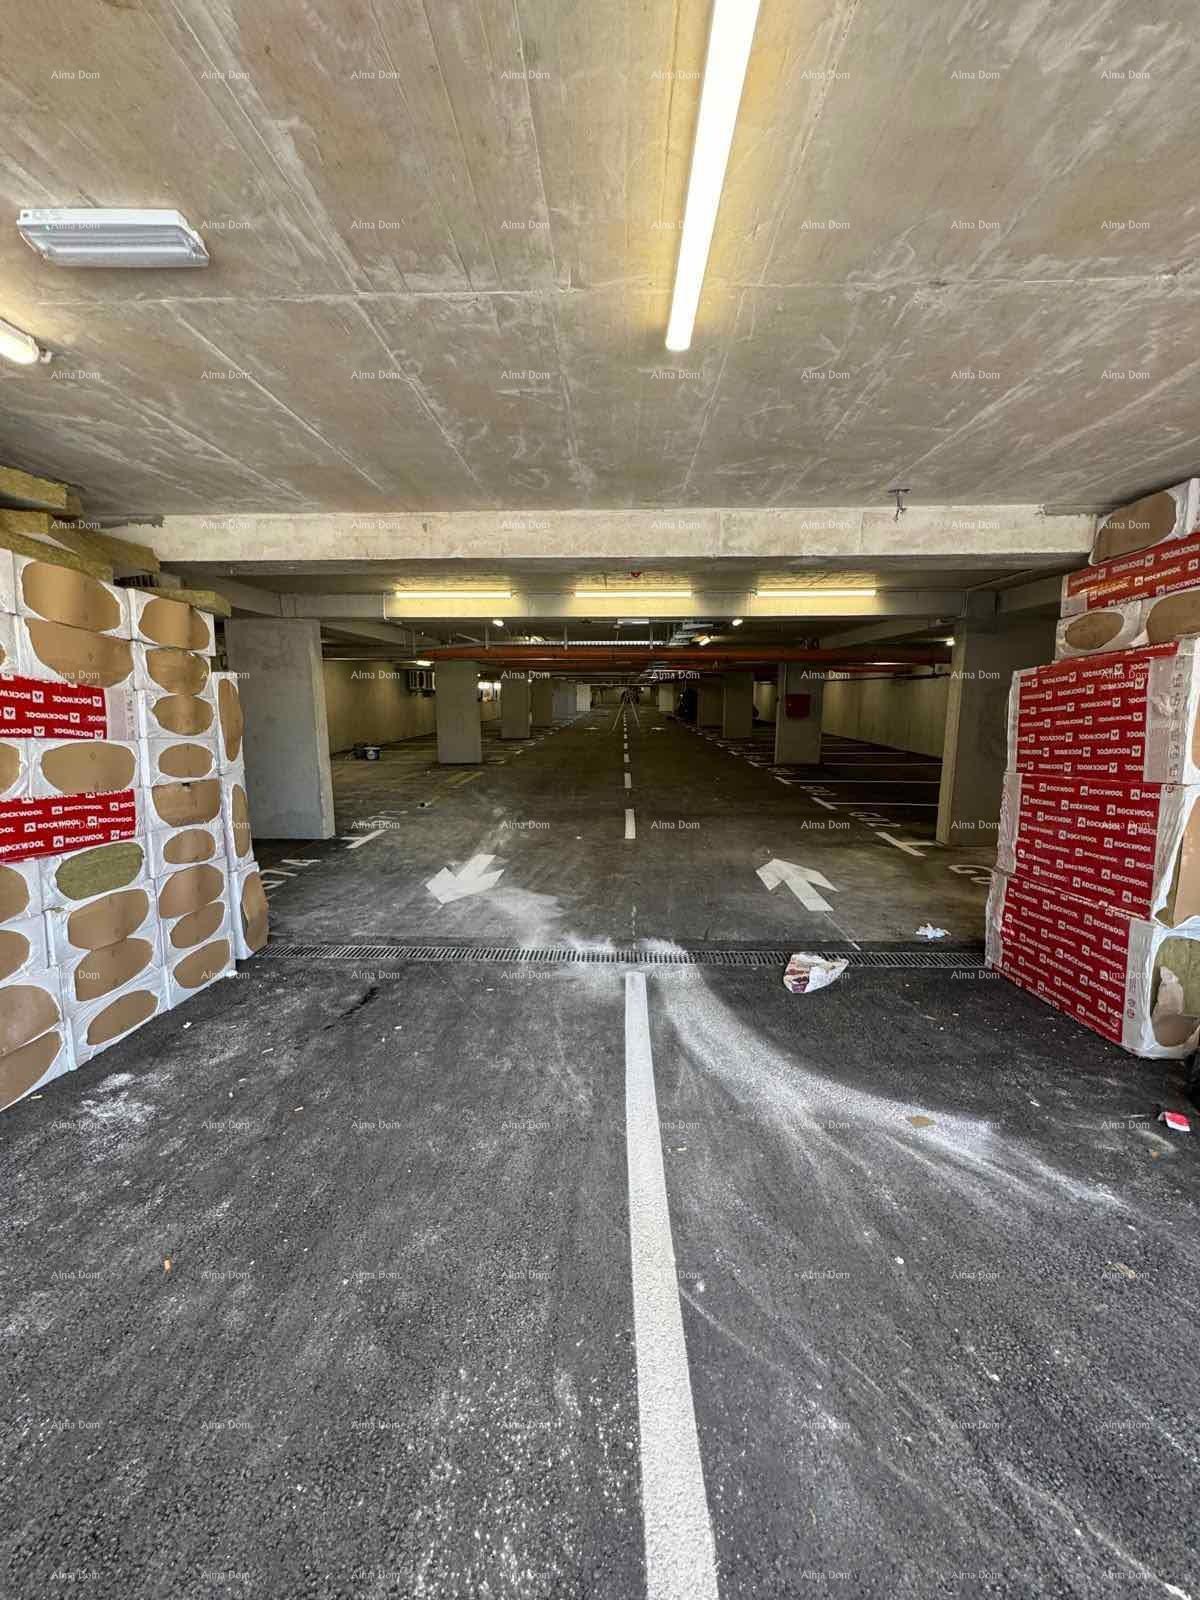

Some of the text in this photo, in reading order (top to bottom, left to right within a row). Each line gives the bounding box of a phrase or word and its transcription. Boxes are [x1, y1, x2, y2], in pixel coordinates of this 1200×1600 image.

[25, 712, 68, 720] ROCKWOOL
[1117, 807, 1154, 818] ROCKWOOL
[65, 834, 104, 844] ROCKWOOL
